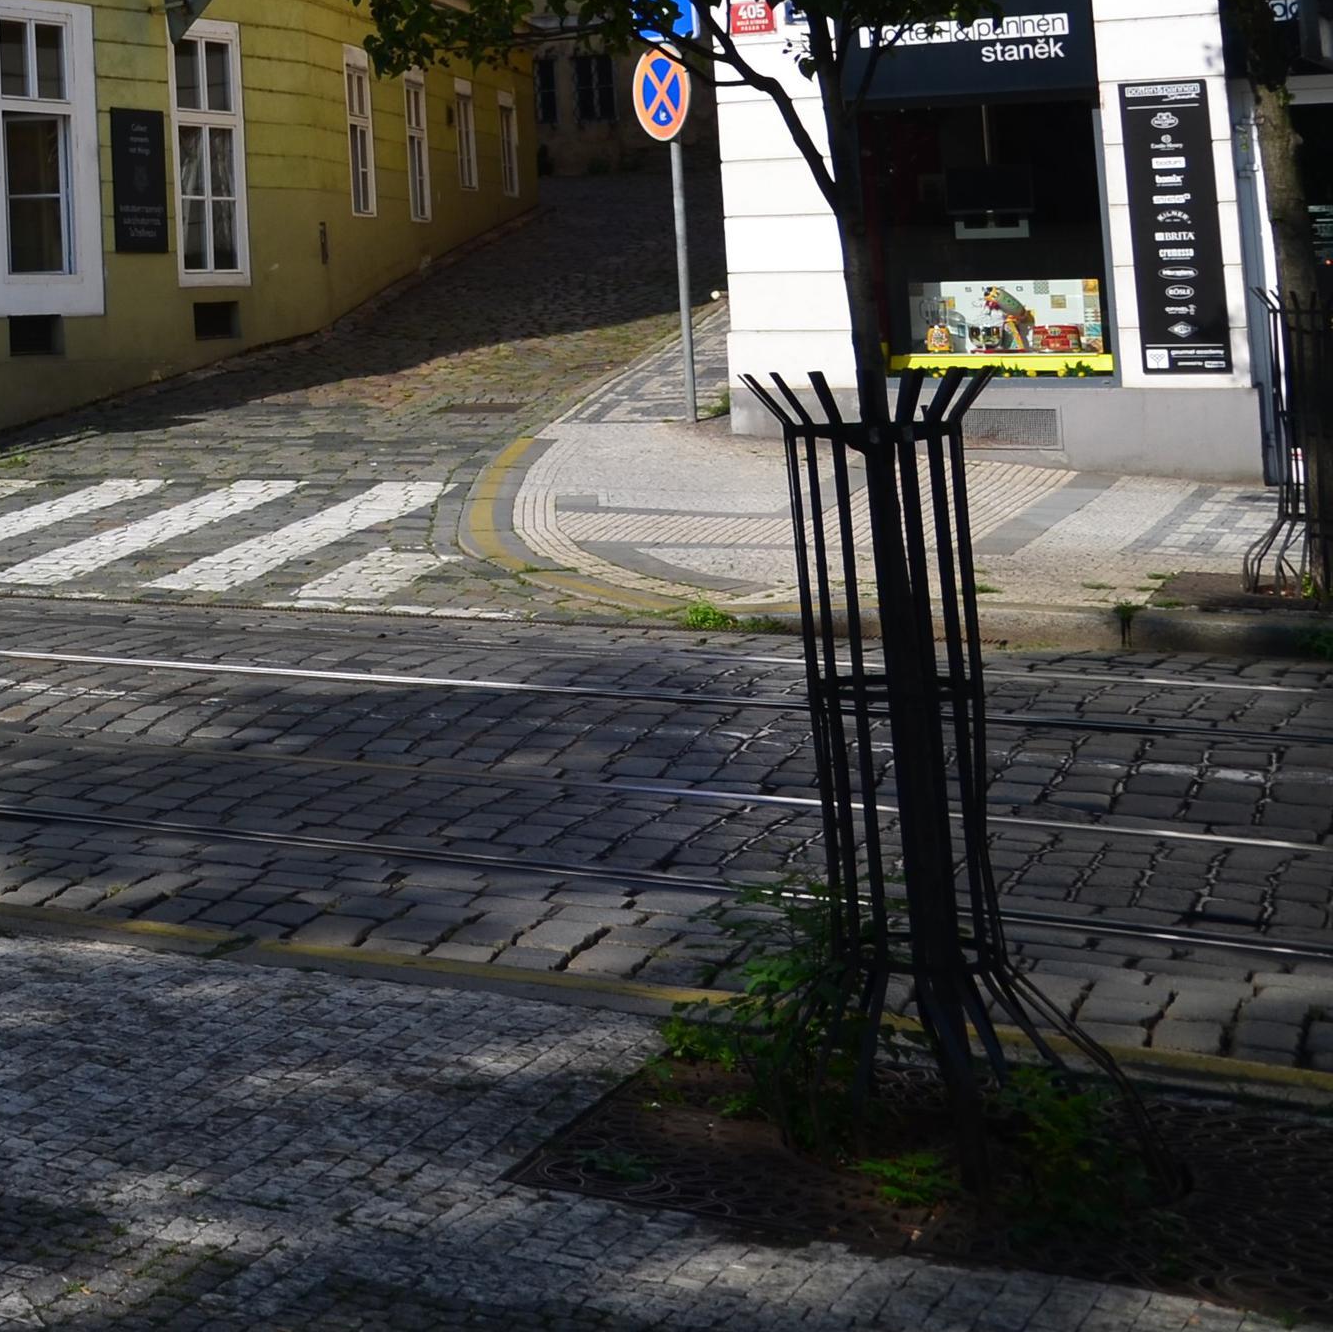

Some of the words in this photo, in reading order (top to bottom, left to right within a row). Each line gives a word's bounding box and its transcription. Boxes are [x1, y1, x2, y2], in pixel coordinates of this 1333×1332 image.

[738, 4, 766, 19] 405
[981, 37, 1064, 62] staněk
[1164, 231, 1195, 241] BRITA
